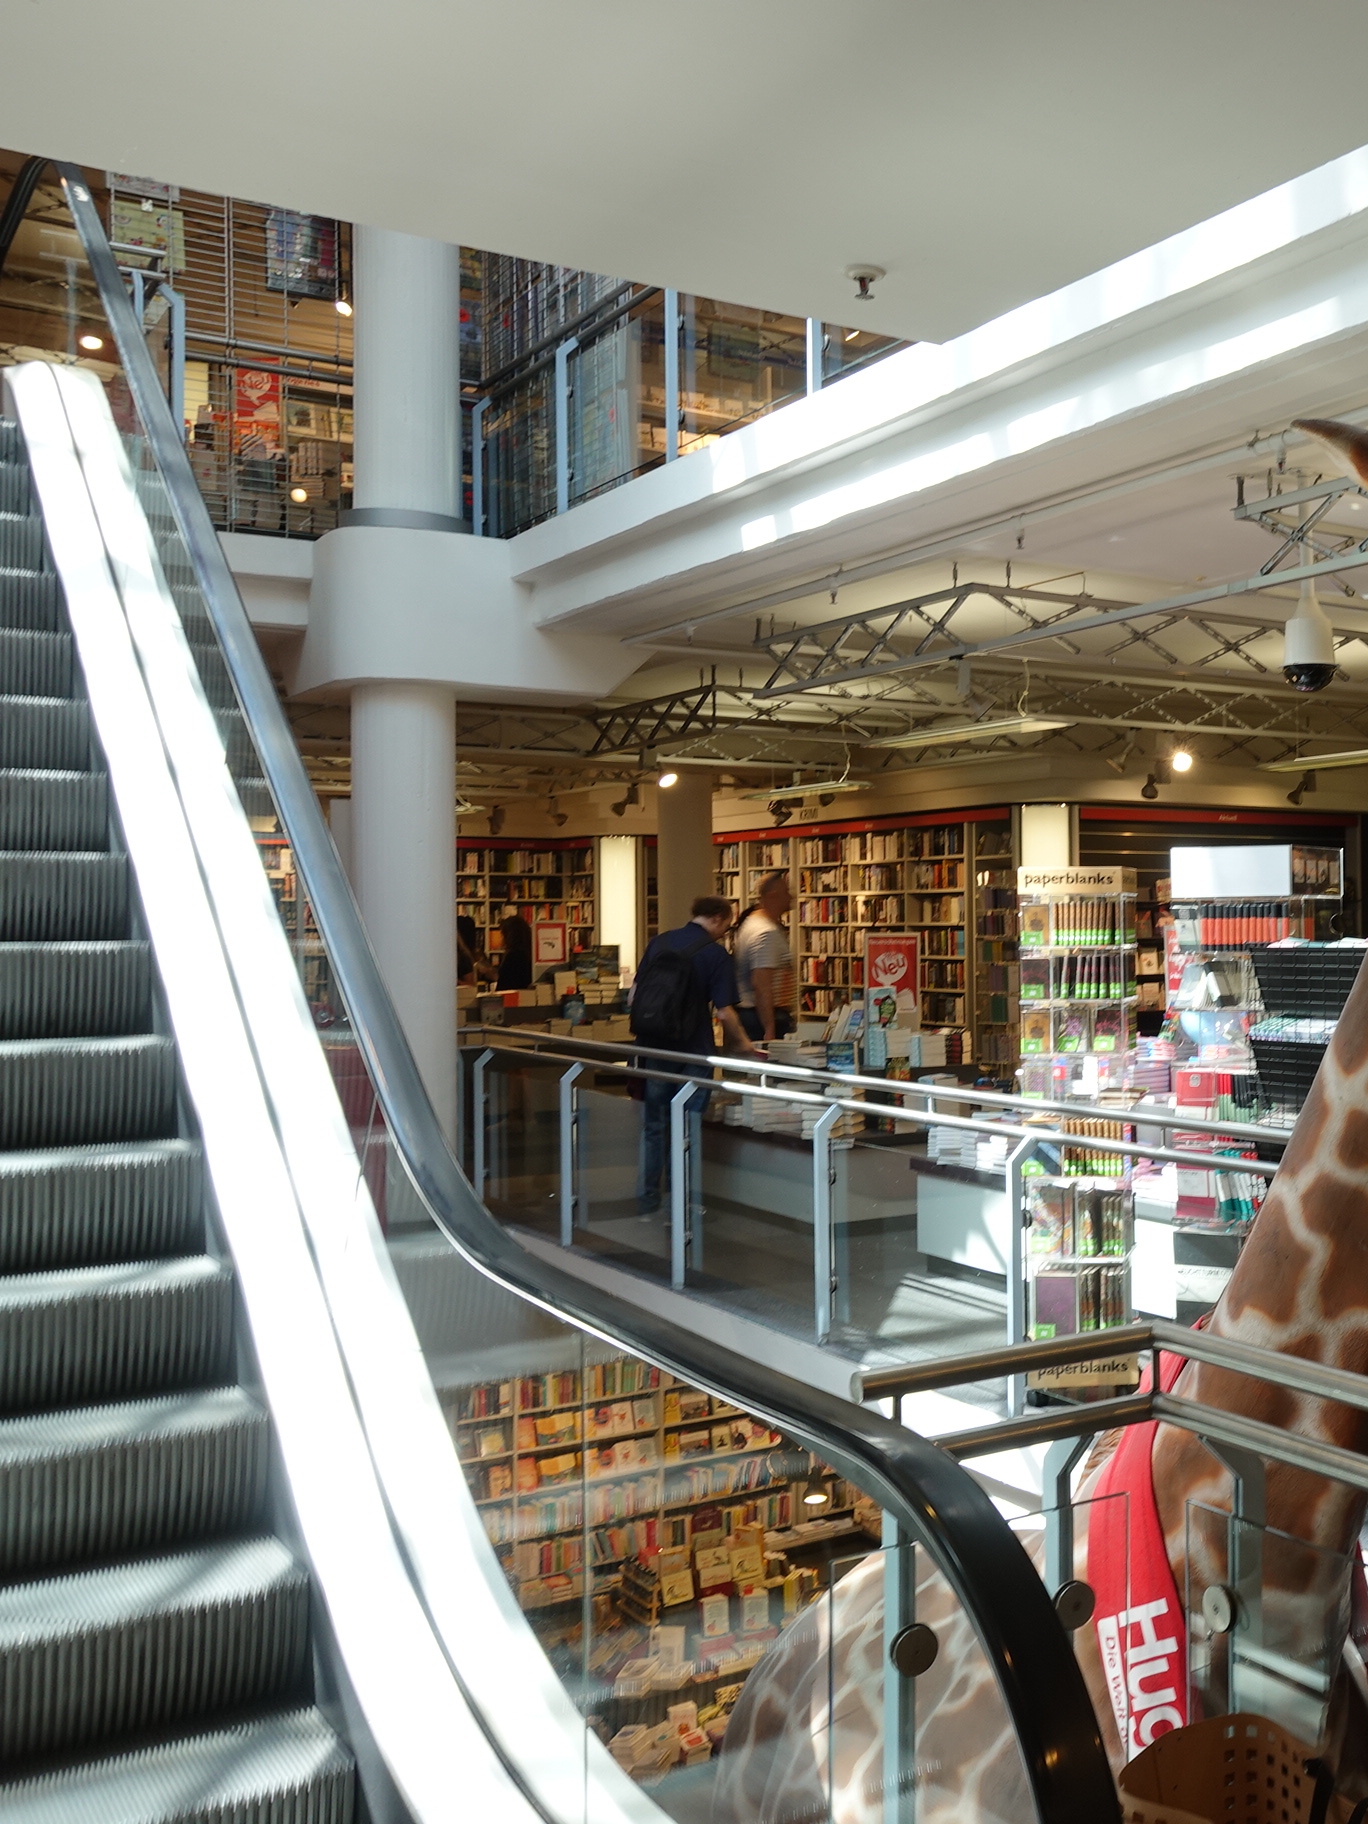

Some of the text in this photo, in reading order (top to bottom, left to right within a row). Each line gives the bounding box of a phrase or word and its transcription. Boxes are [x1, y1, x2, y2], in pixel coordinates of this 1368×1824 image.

[1024, 871, 1114, 888] paperblanks
[874, 955, 905, 979] Neu
[1037, 1360, 1128, 1380] paperblanks
[1105, 1636, 1117, 1669] Die
[1111, 1675, 1127, 1721] Welt
